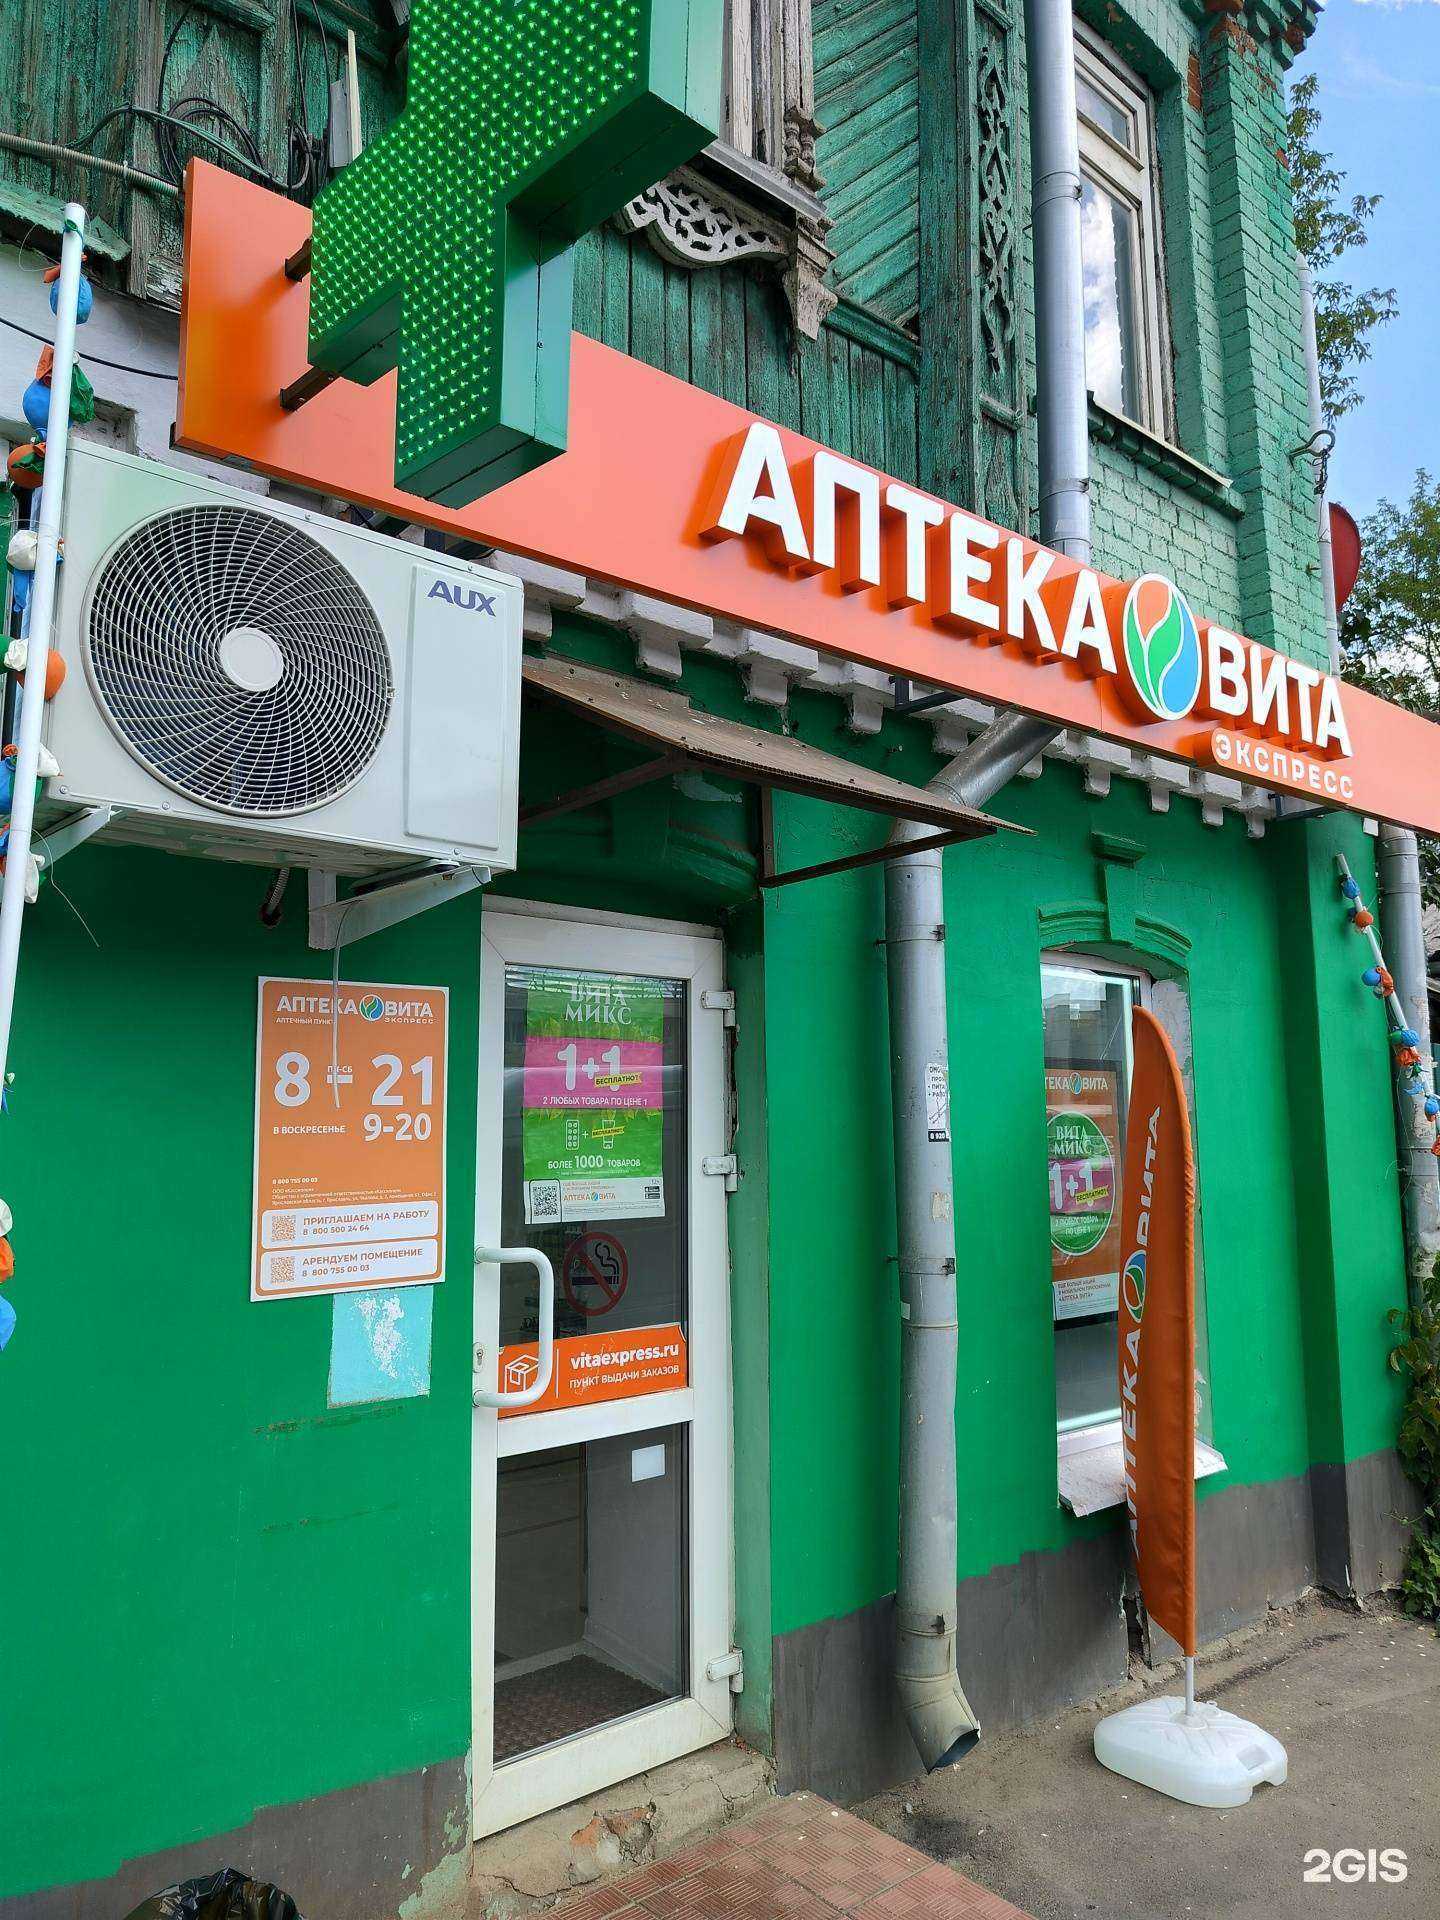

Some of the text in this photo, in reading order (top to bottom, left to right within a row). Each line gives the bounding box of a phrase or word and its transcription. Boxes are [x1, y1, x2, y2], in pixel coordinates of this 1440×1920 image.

[428, 580, 497, 617] AUX
[718, 421, 1353, 758] АПТЕКА ВИТА
[1215, 734, 1354, 798] ЭКСПРЕСС
[276, 995, 433, 1017] АПТЕКА ВИТА
[565, 1004, 632, 1024] МИКС
[384, 1017, 434, 1025] ЭКСПРЕСС
[557, 1043, 620, 1091] 1+1
[274, 1051, 311, 1107] 8
[371, 1054, 432, 1106] 21
[1082, 1077, 1108, 1090] ВИТА
[542, 1096, 548, 1105] 2
[549, 1096, 580, 1105] ЛЮБЫХ
[581, 1096, 609, 1106] ТОВАРА
[611, 1097, 622, 1105] ПО
[623, 1097, 642, 1106] ЦЕНЕ
[273, 1125, 346, 1135] В ВОСКРЕСЕНЬЕ
[363, 1112, 432, 1142] 9-20
[1056, 1125, 1088, 1140] ВИТА
[1054, 1140, 1092, 1155] МИКС
[548, 1155, 641, 1169] БОЛЕЕ 1000 ТОВАРОВ
[303, 1209, 430, 1226] ПРИГЛАШАЕМ НА РАБОТУ
[303, 1228, 308, 1236] 8
[312, 1227, 329, 1235] 800
[330, 1226, 346, 1234] 500
[302, 1248, 423, 1266] АРЕНДУЕМ ПОМЕЩЕНИЕ
[312, 1268, 329, 1276] 800
[330, 1266, 346, 1274] 755
[347, 1265, 358, 1273] 00
[360, 1264, 370, 1272] 03
[570, 1343, 680, 1370] vitaexpress.ru
[569, 1364, 680, 1389] ПУНКТ ВЫДАЧИ ЗАКАЗОВ
